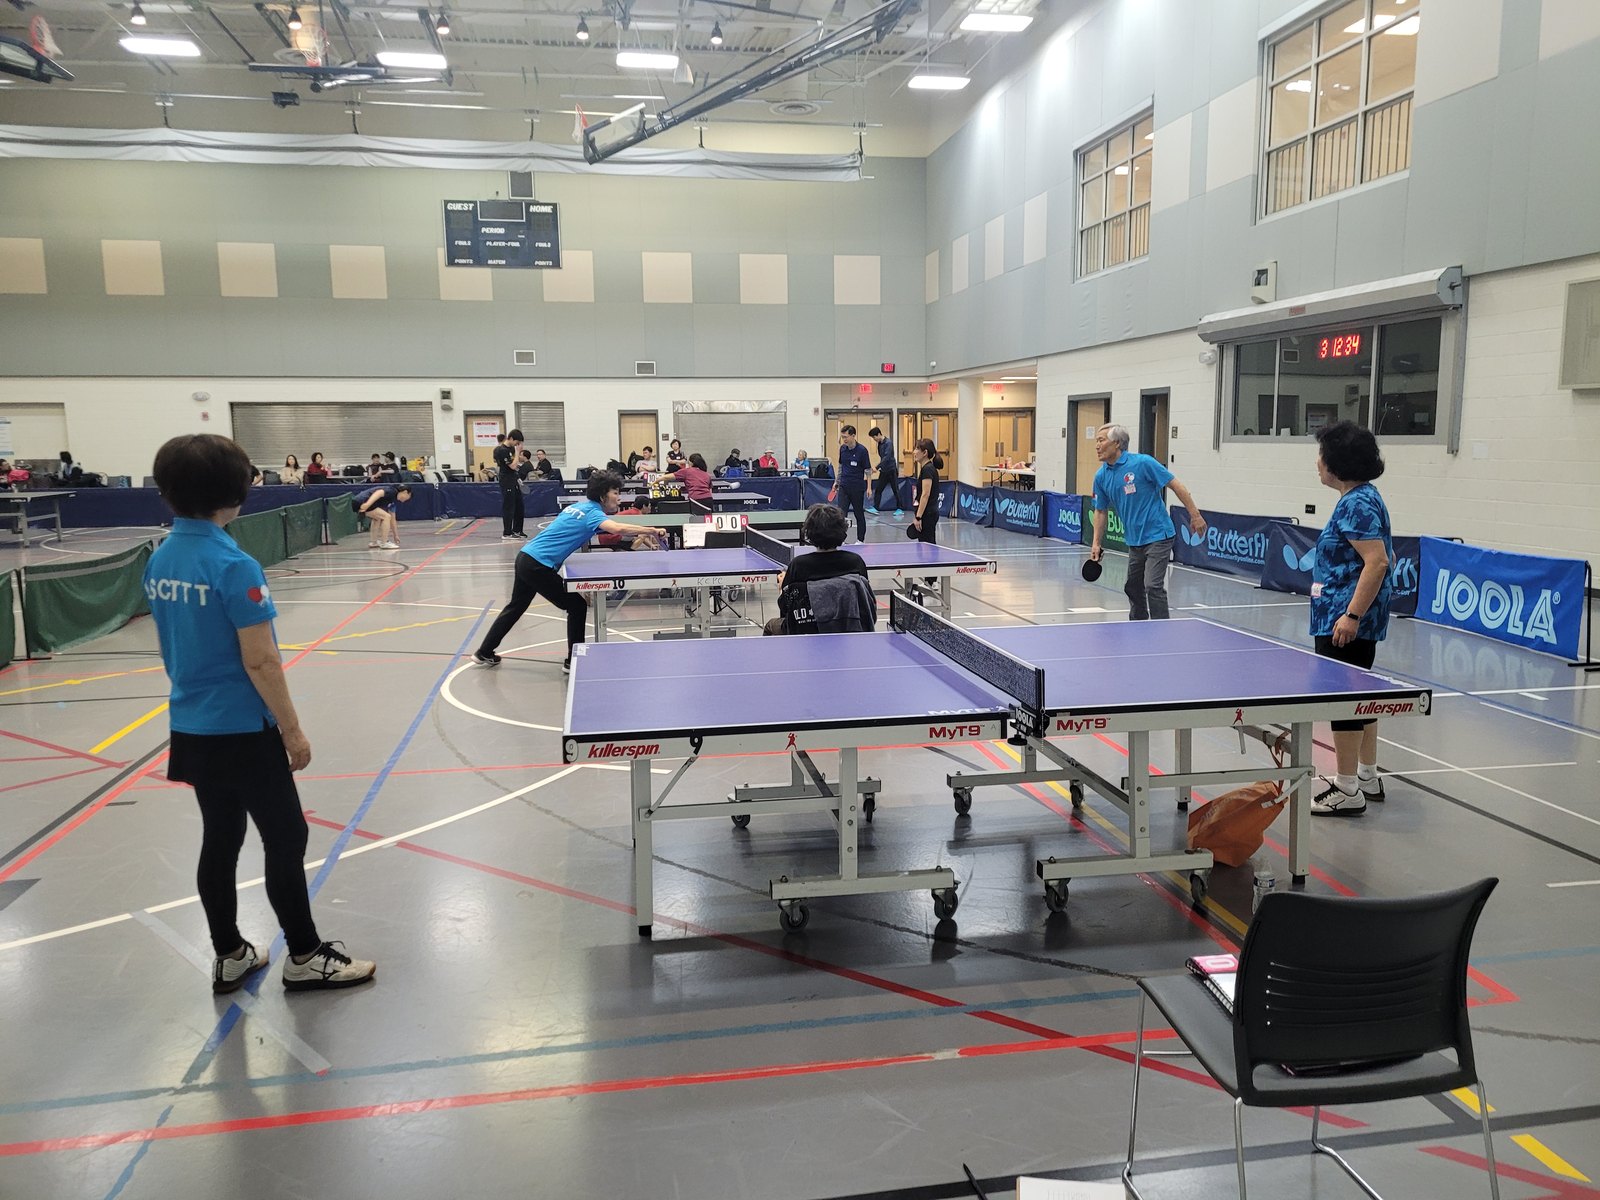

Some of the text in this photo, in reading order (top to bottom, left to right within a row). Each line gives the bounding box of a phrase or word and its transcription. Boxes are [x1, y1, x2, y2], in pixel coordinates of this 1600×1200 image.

[446, 202, 474, 211] GUEST
[529, 205, 553, 213] HOME
[1006, 499, 1040, 523] Butterfly
[730, 516, 738, 529] 0
[612, 579, 625, 589] 10
[1431, 568, 1558, 645] JOOLA
[1354, 692, 1430, 716] killerspin 9
[564, 738, 661, 763] 9 killerspin
